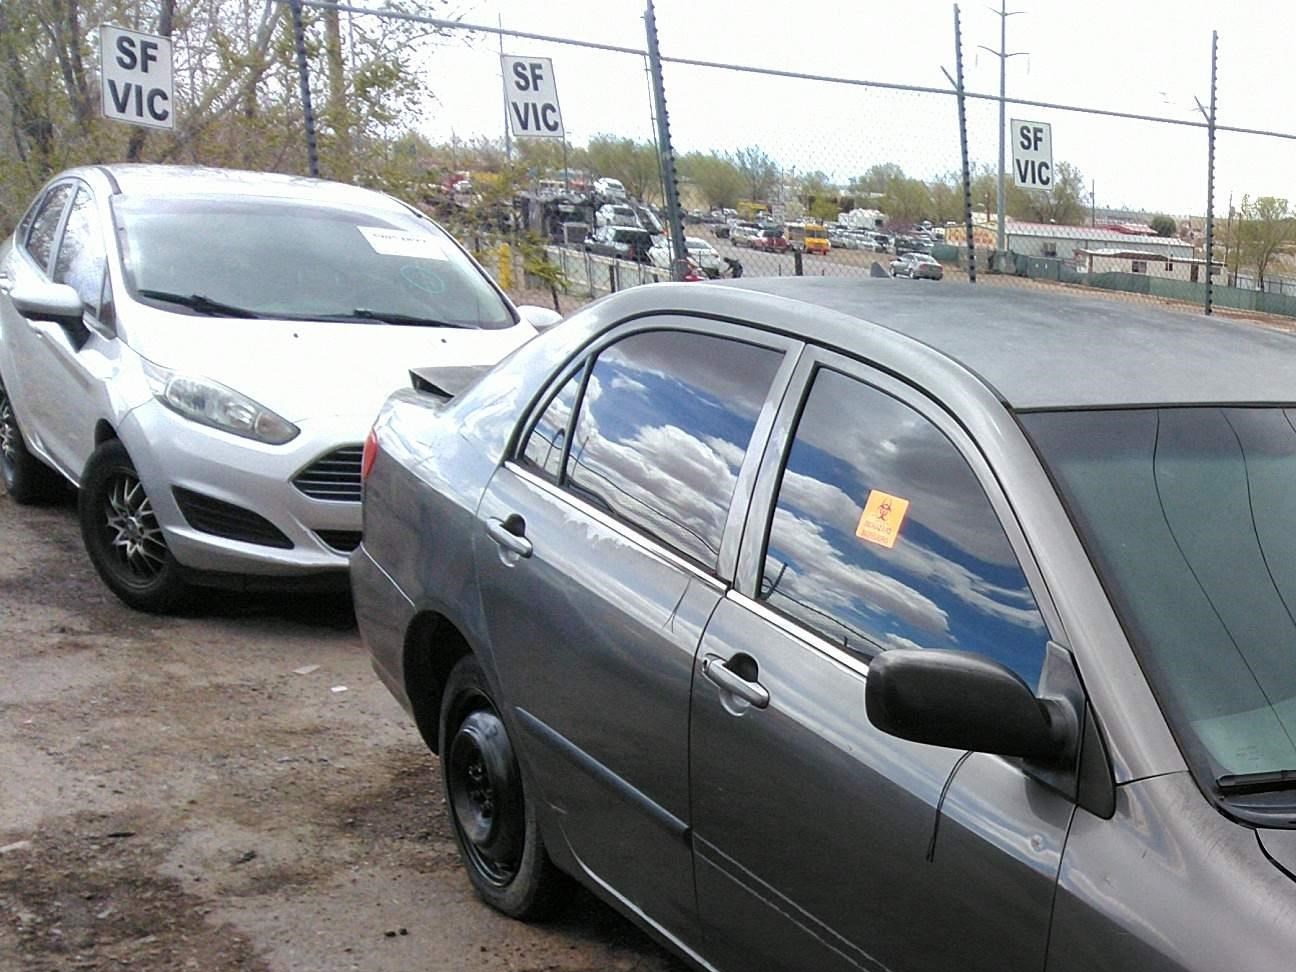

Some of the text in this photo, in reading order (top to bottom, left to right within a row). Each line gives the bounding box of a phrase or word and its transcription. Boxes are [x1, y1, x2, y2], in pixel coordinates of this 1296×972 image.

[116, 35, 158, 73] SF
[513, 61, 543, 91] SF
[107, 79, 169, 121] VIC
[511, 102, 559, 132] VIC
[1020, 126, 1043, 151] SF
[1016, 159, 1050, 185] VIC
